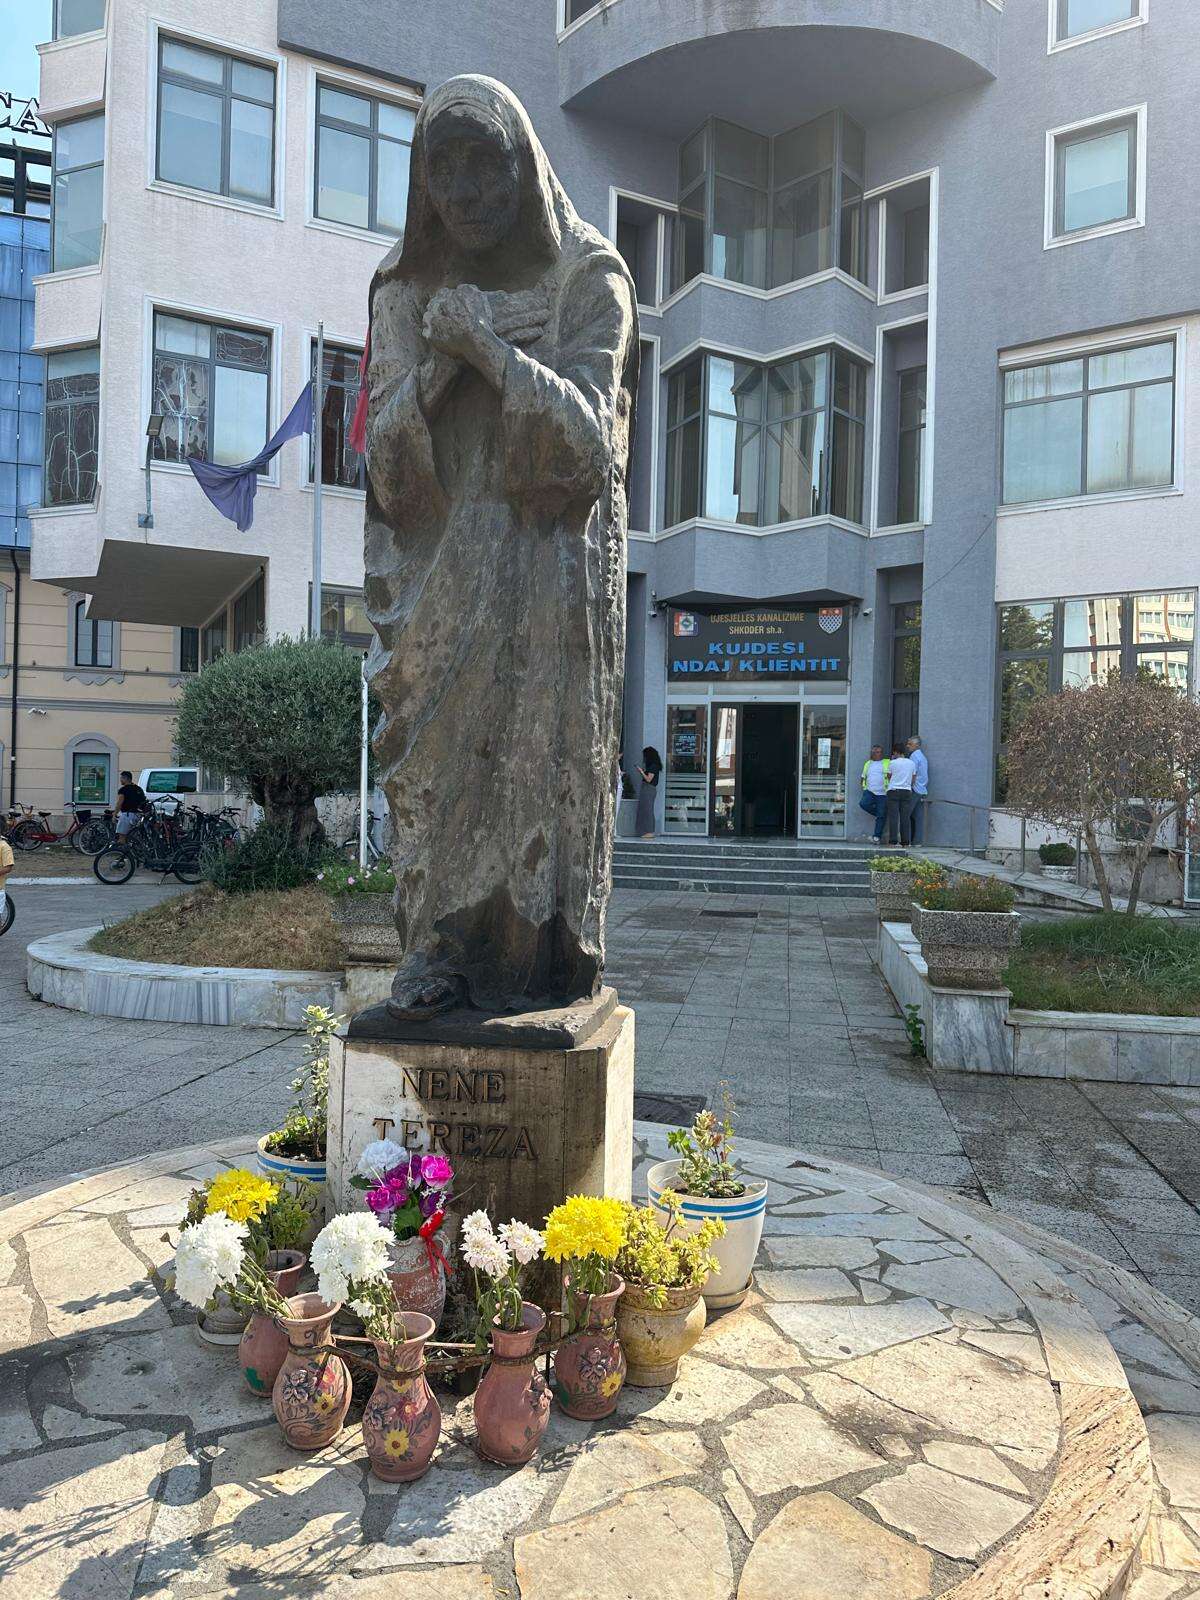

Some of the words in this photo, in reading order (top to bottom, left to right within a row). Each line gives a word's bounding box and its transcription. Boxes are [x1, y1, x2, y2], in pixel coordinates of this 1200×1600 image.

[757, 612, 804, 622] KANALIZIME
[766, 625, 785, 635] sh.a.
[708, 641, 805, 656] KUJDESI
[673, 659, 731, 673] NDAJ
[739, 658, 841, 673] KLIENTIT
[400, 1067, 507, 1104] NENE
[372, 1117, 538, 1161] TEREZA
